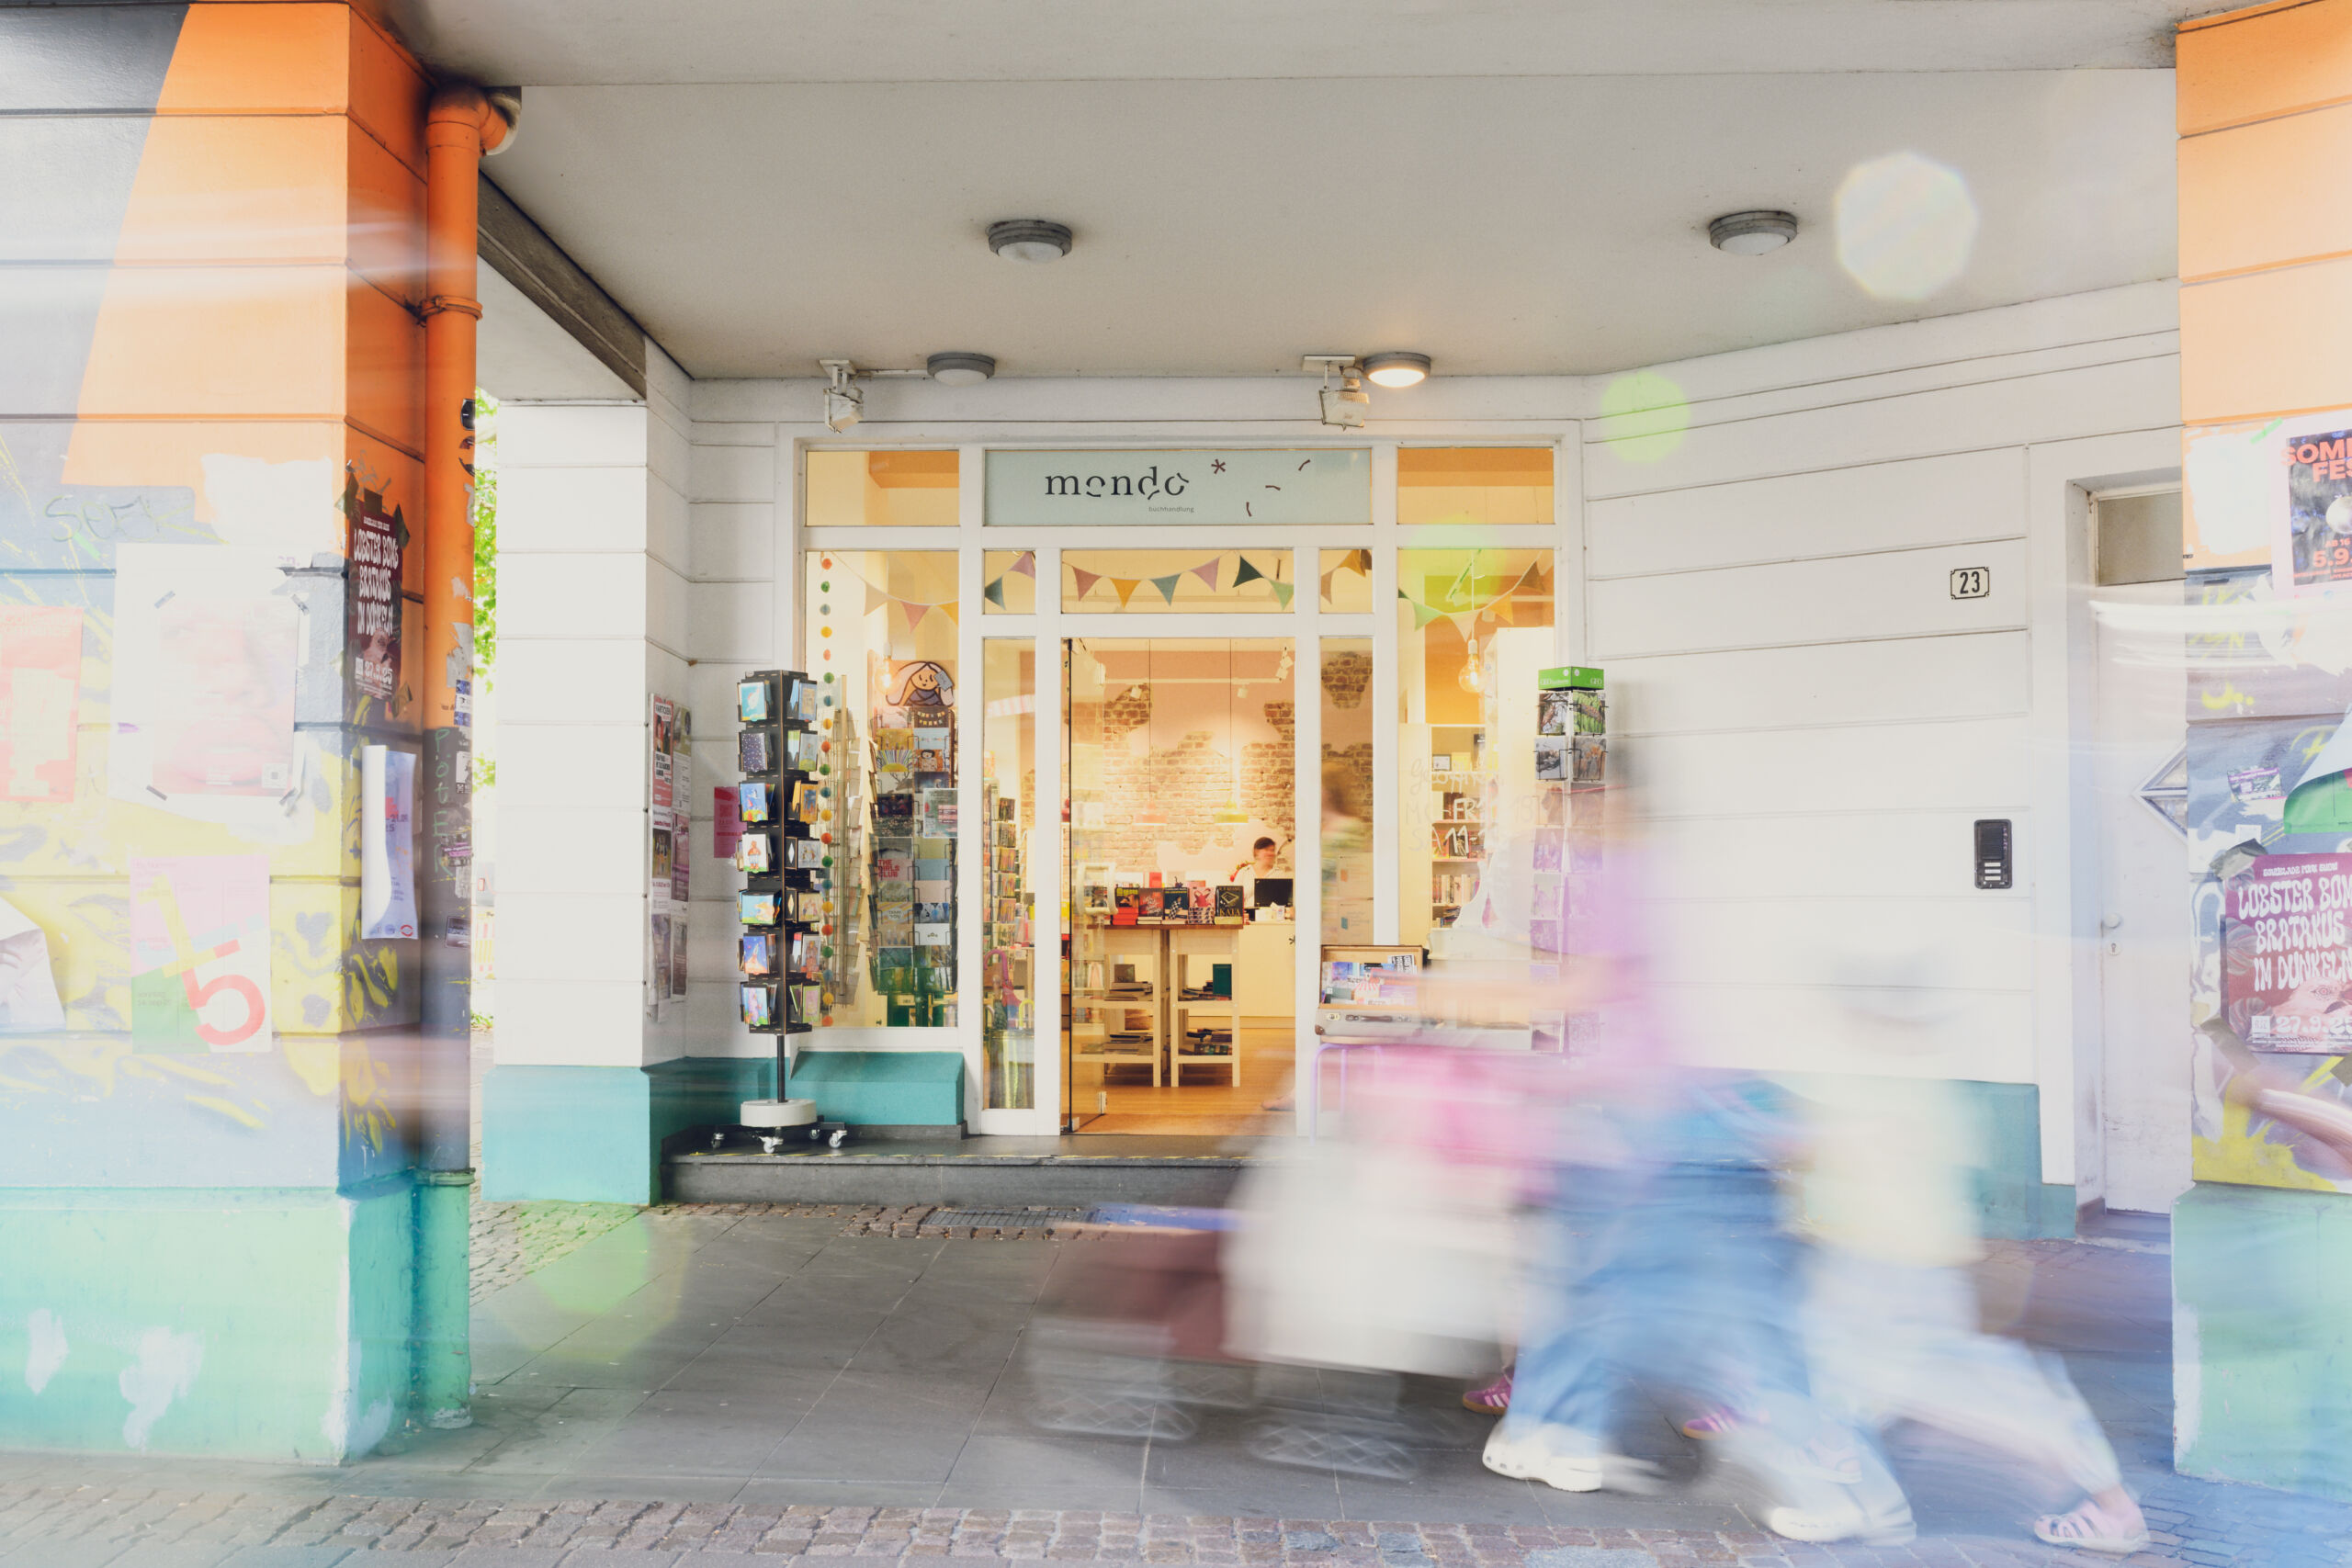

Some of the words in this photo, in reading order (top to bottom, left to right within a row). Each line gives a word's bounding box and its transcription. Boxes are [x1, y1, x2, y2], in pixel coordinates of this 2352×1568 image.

[2280, 437, 2352, 466] SOM
[1045, 467, 1189, 501] mondo
[1148, 505, 1194, 513] buchhandlung
[354, 528, 381, 565] LOBSTER
[2313, 547, 2352, 568] 5.9
[1959, 570, 1982, 595] 23
[2238, 877, 2314, 920] LOBSTER
[2255, 910, 2346, 955] BRATAKUS
[2254, 956, 2272, 993] IM
